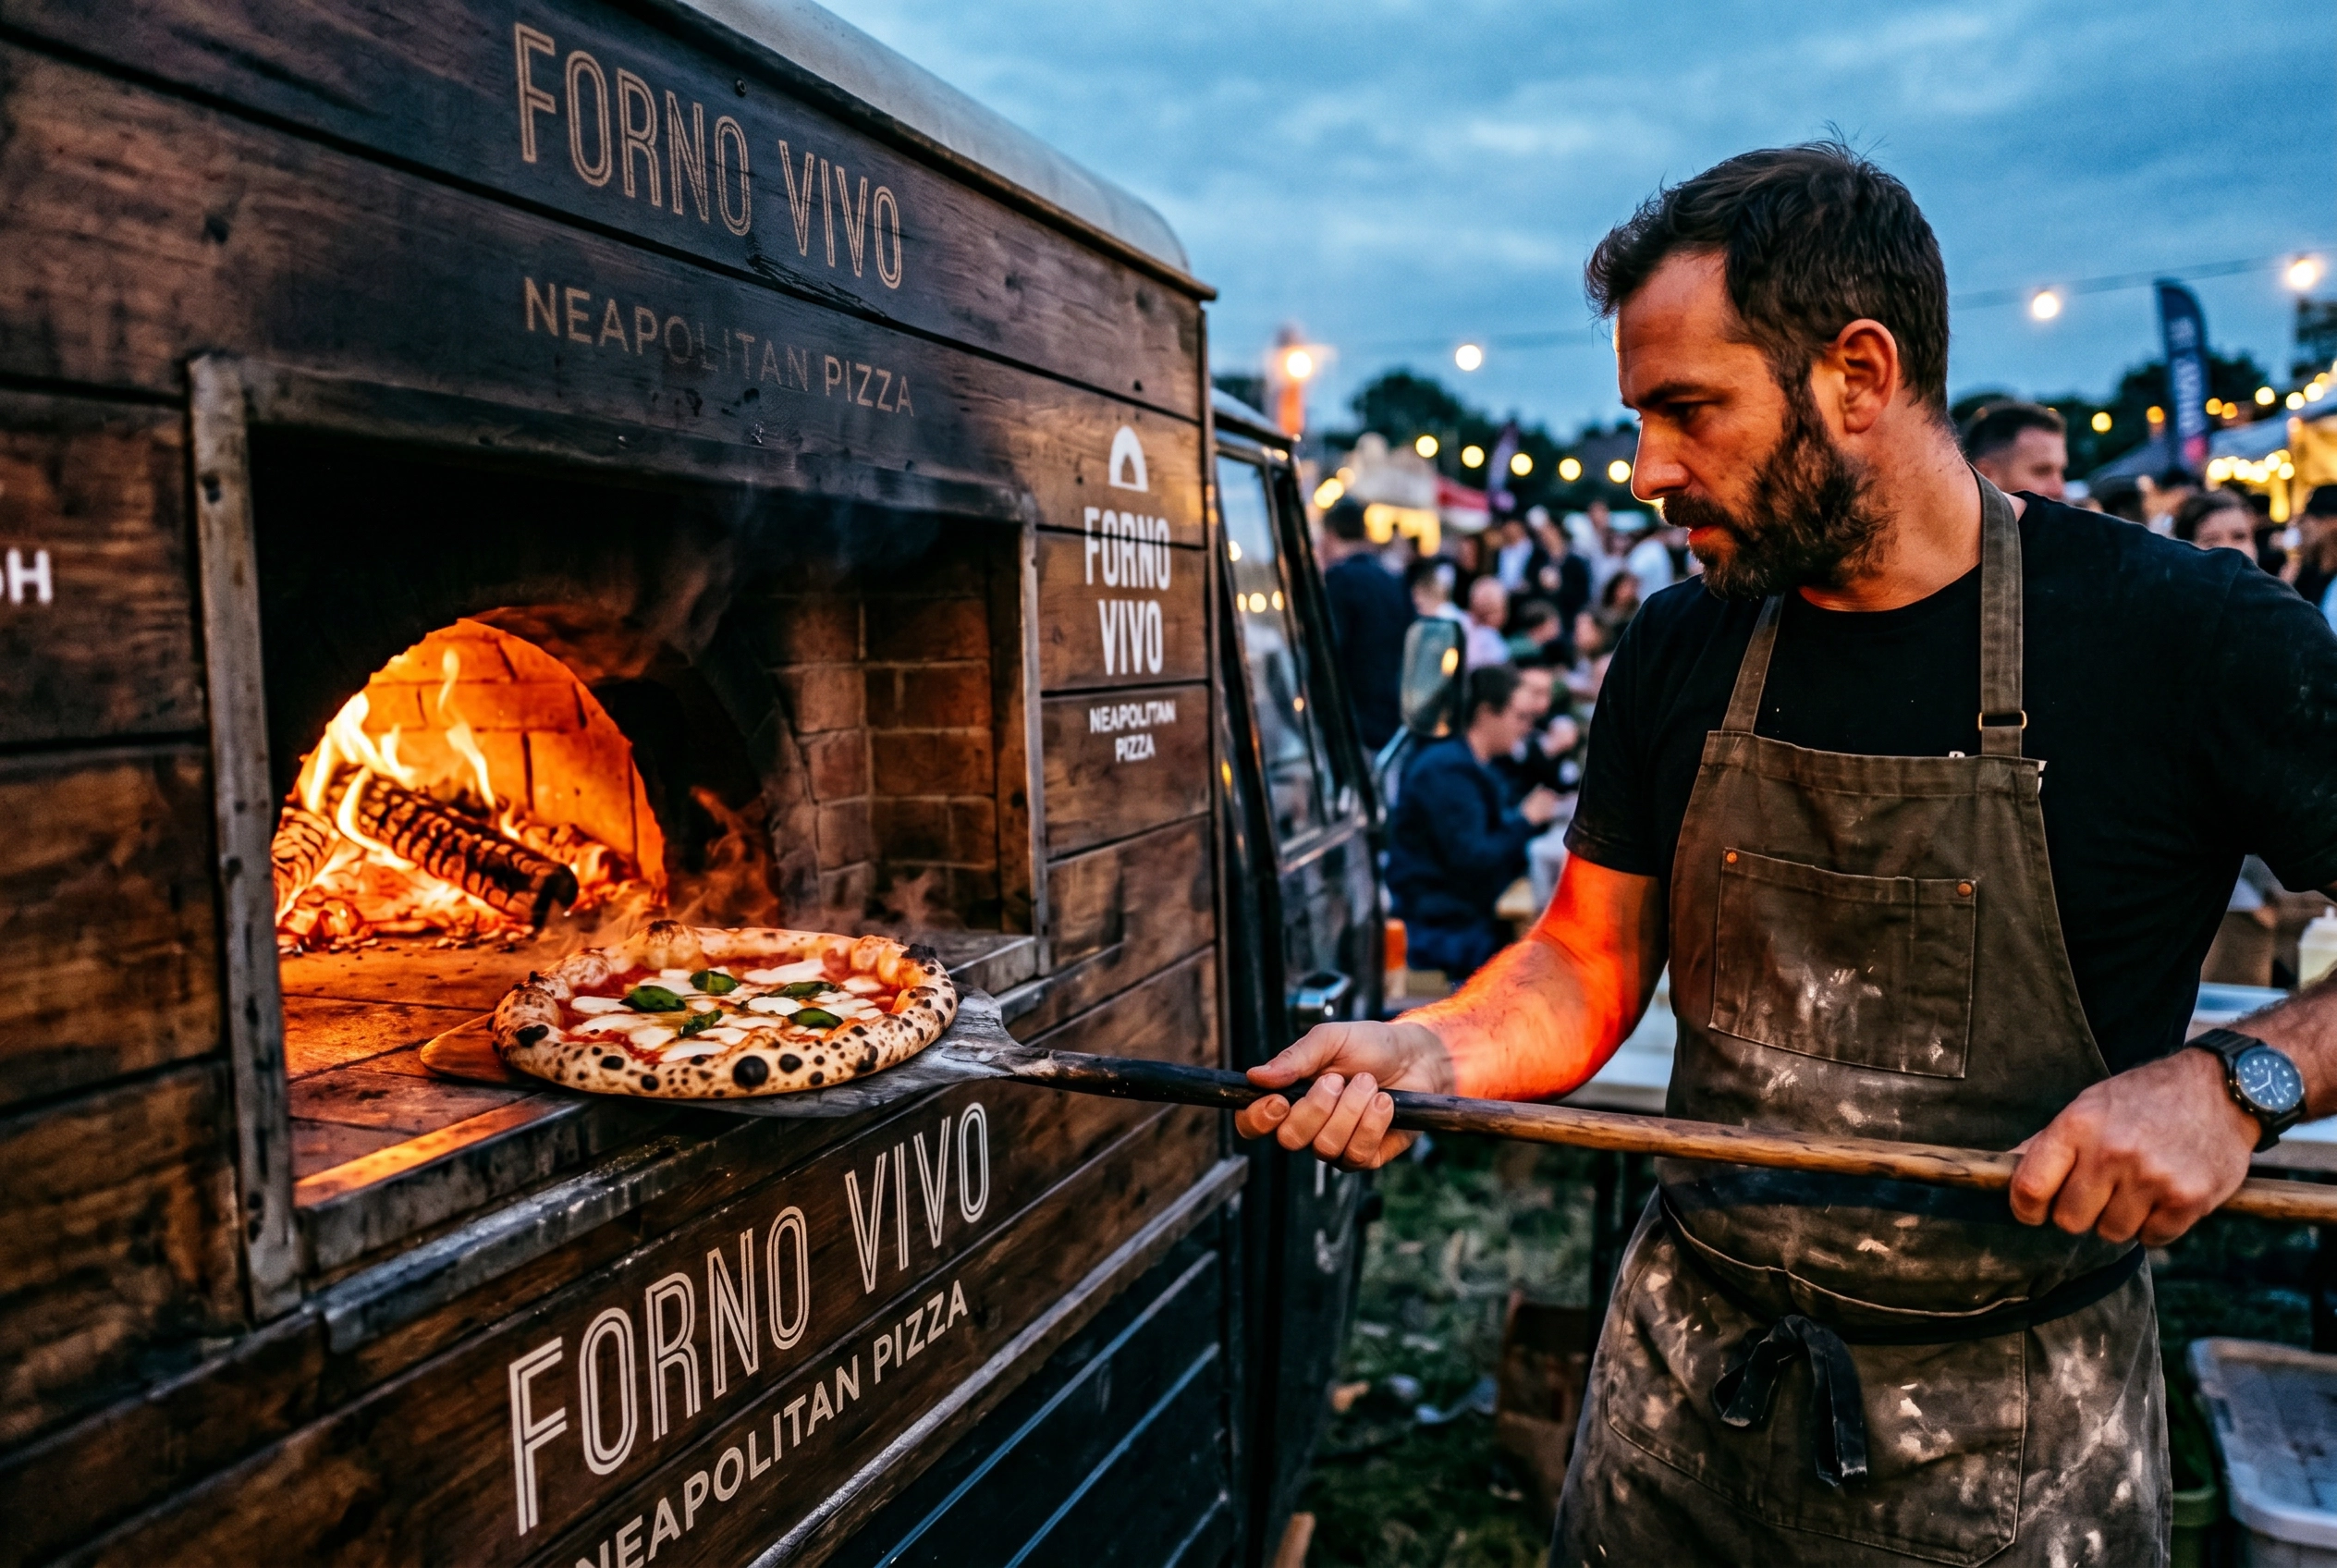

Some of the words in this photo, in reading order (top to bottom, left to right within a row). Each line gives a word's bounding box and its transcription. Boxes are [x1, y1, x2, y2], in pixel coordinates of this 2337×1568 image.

[515, 22, 752, 237] FORNO
[778, 140, 902, 289] VIVO
[524, 277, 809, 392] NEAPOLITAN
[825, 354, 914, 417] PIZZA
[0, 547, 53, 606] H
[1084, 507, 1170, 590] FORNO
[1098, 599, 1162, 675] VIVO
[1090, 700, 1176, 733] NEAPOLITAN
[1115, 734, 1155, 763] PIZZA
[509, 1206, 810, 1536] FORNO
[845, 1102, 989, 1295] VIVO
[874, 1280, 969, 1385] PIZZA
